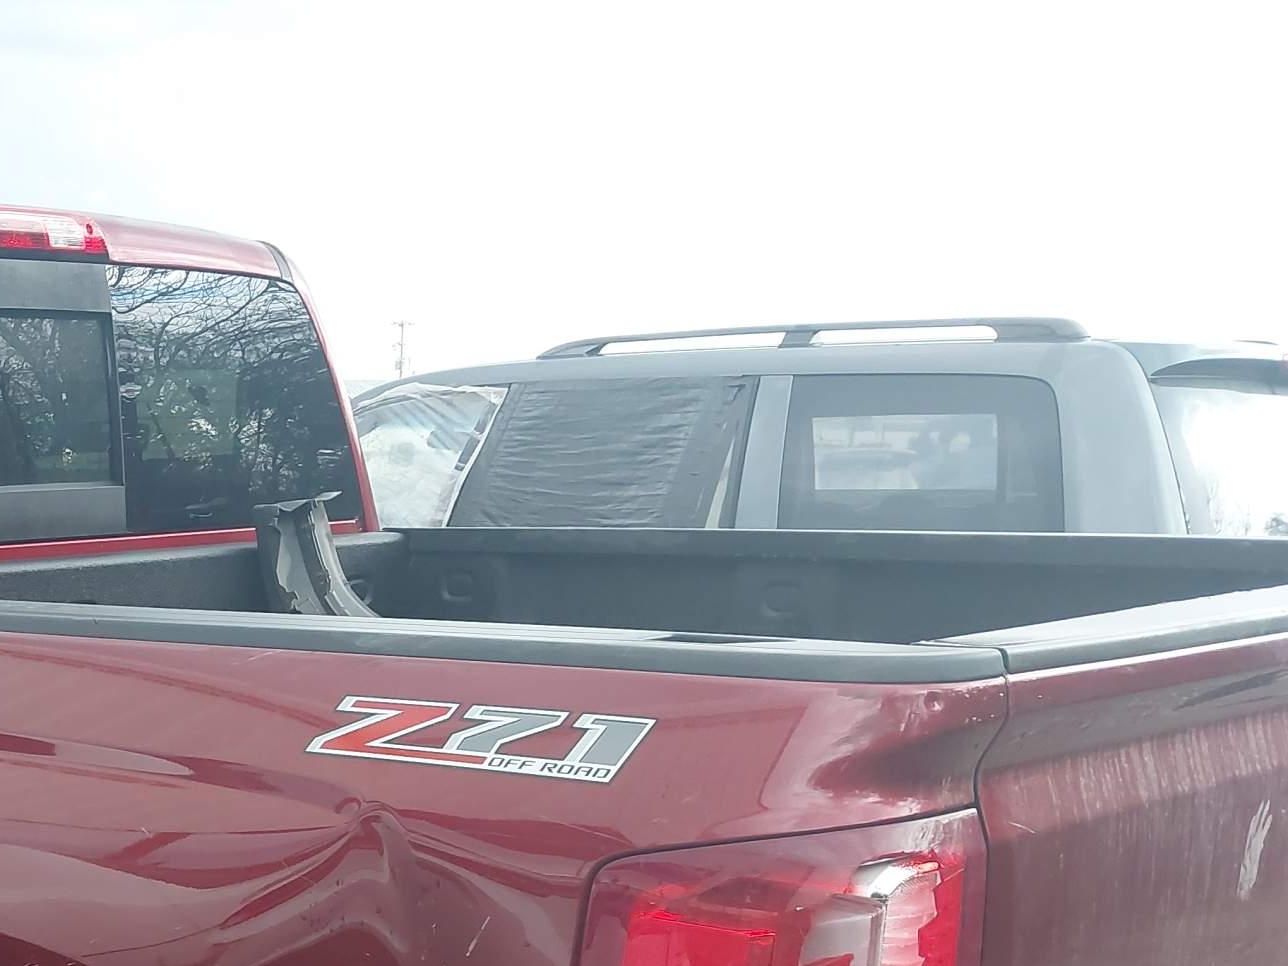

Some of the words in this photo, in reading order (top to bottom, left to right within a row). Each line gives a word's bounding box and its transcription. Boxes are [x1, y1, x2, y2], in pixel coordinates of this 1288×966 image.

[305, 695, 656, 772] Z71
[487, 755, 538, 772] OFF
[539, 761, 613, 780] ROAD
